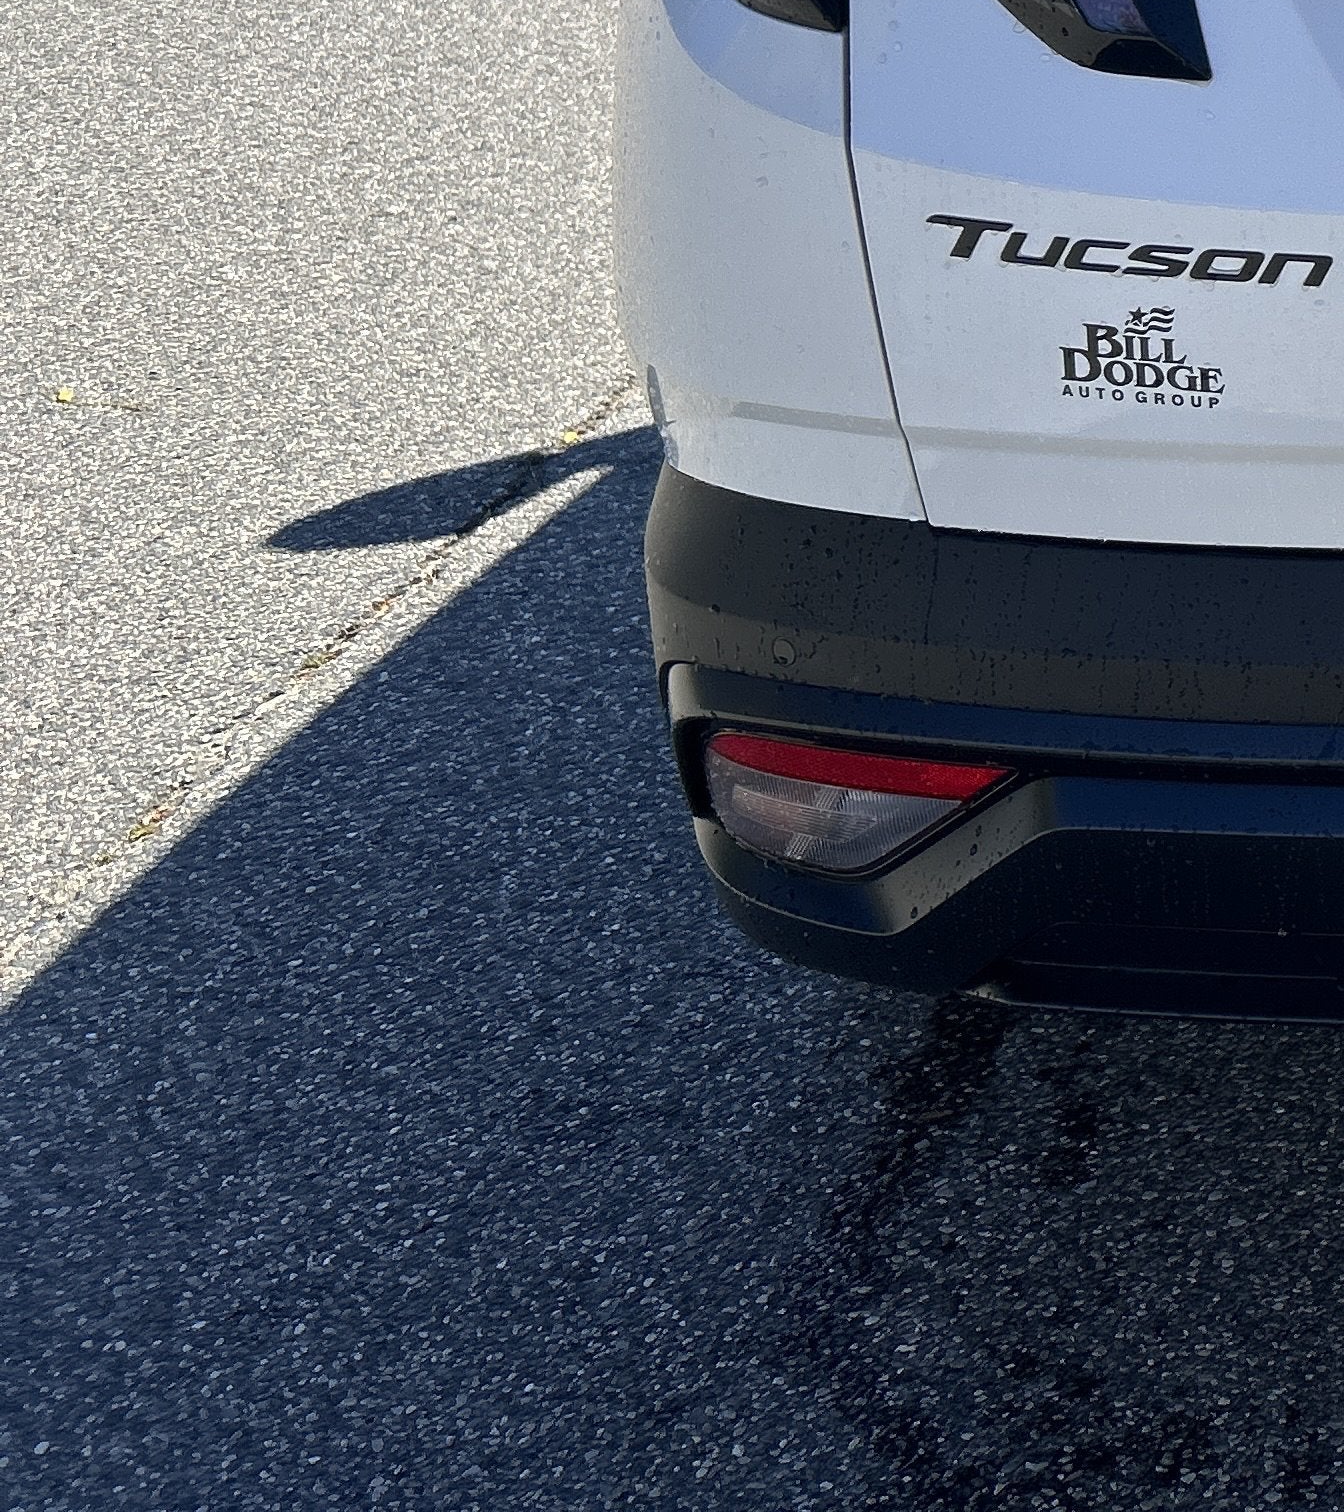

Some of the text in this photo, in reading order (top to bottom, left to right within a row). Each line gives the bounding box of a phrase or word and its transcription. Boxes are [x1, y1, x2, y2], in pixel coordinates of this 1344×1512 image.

[1082, 322, 1187, 365] BILL
[1058, 345, 1226, 395] DODGE
[1061, 384, 1221, 410] AUTO GROUP
